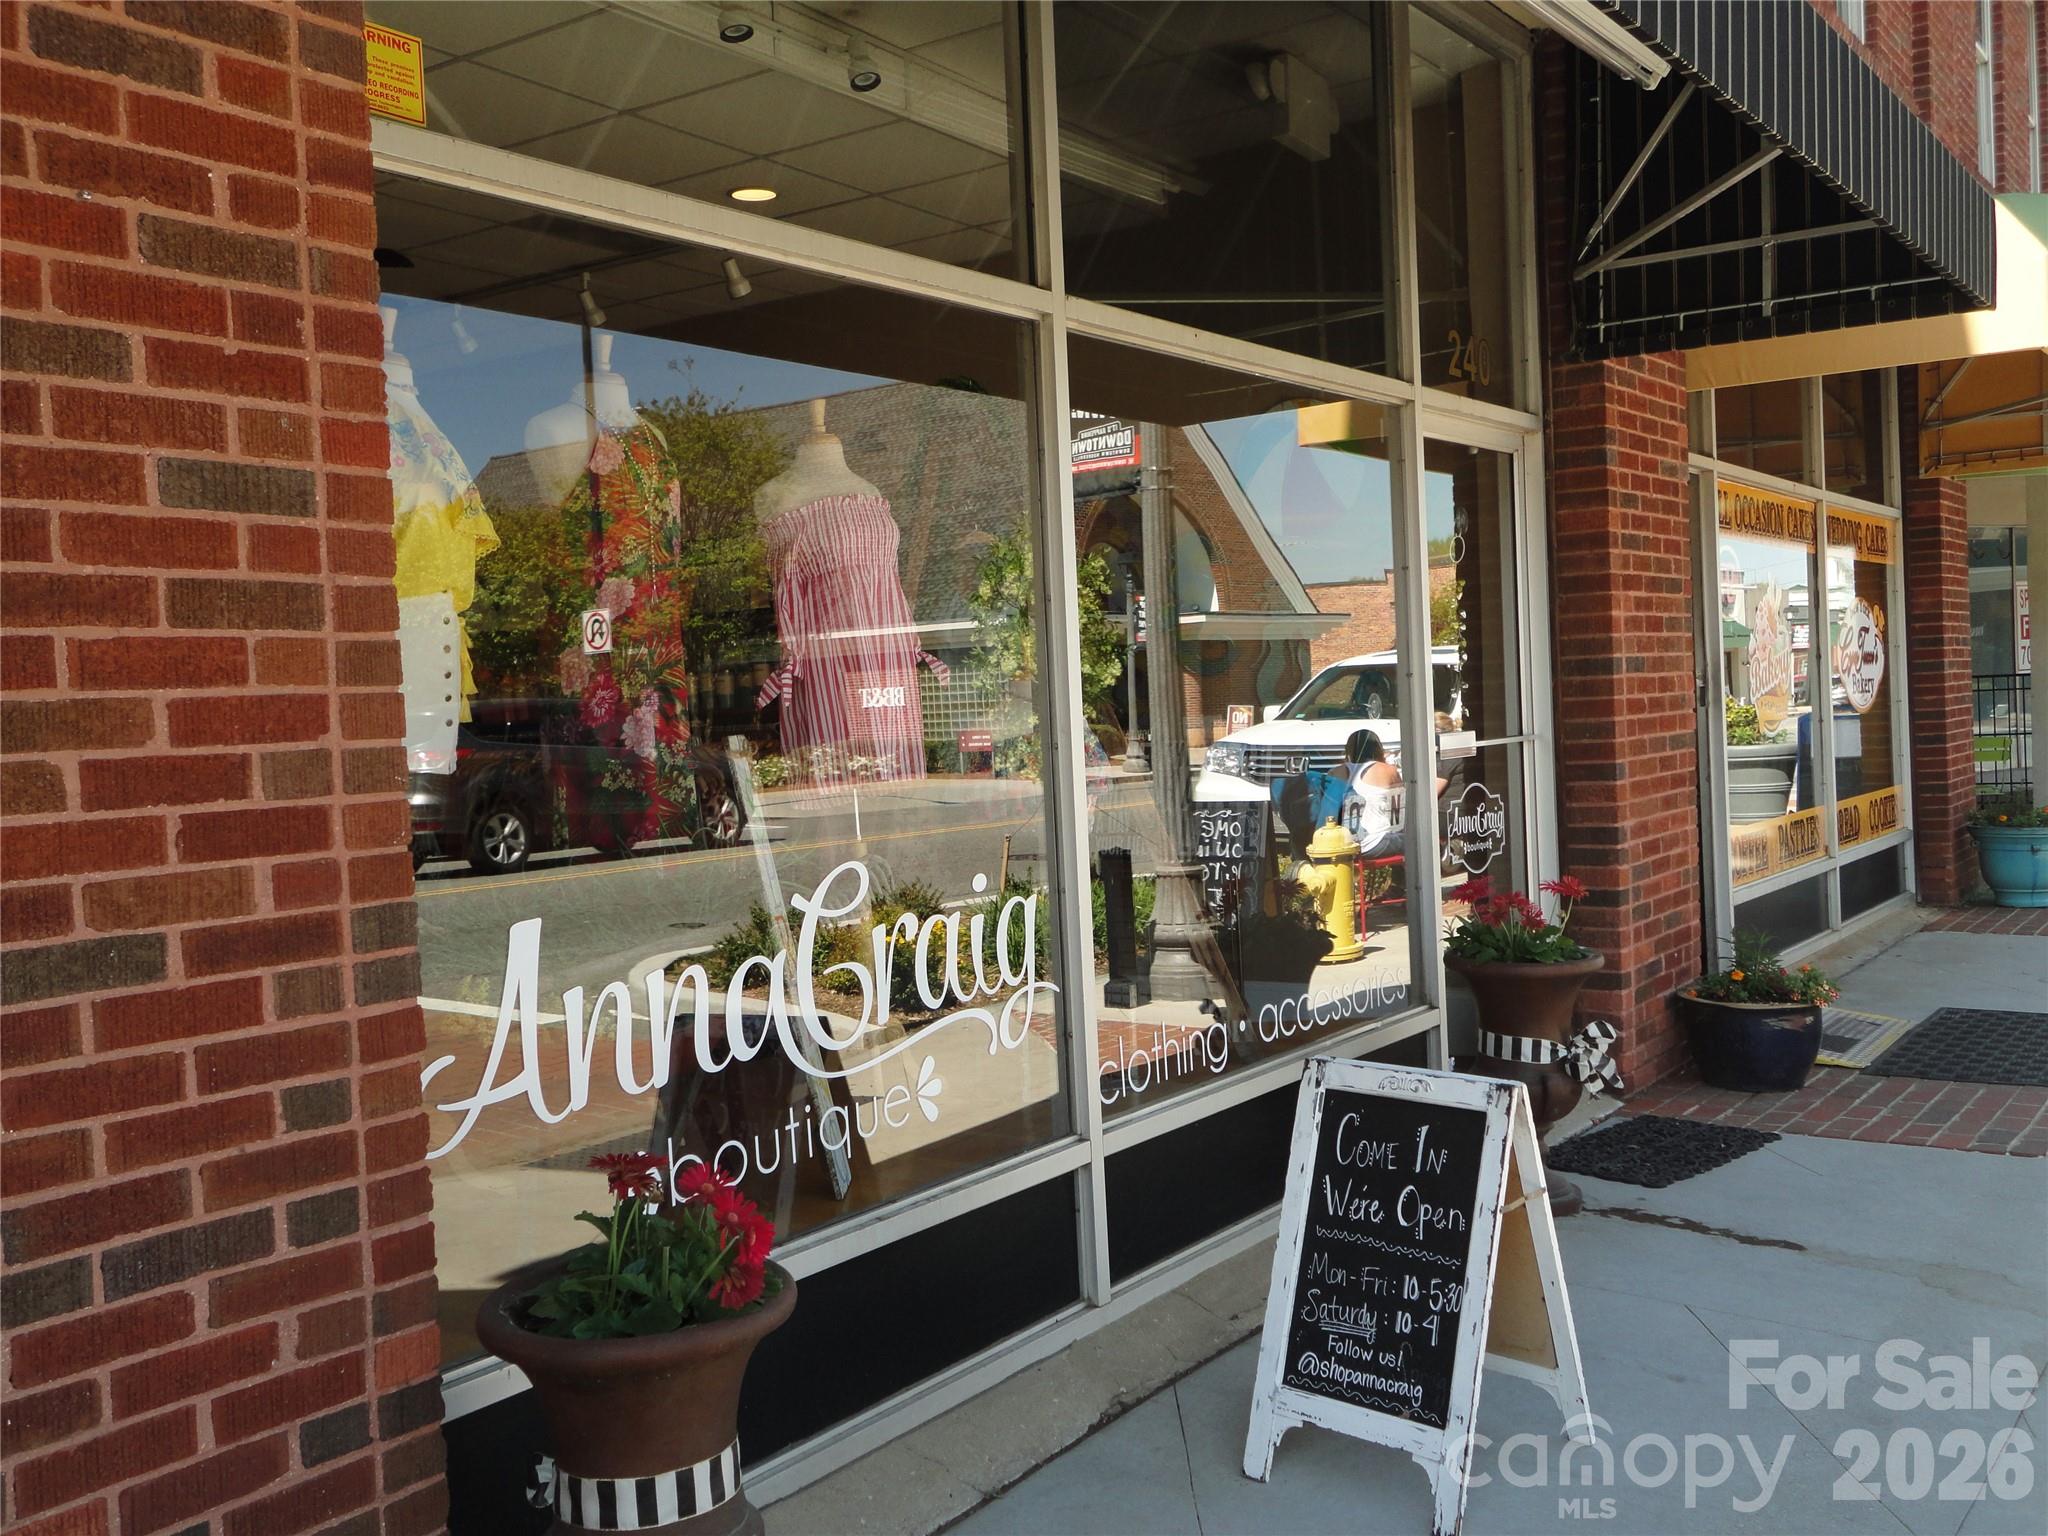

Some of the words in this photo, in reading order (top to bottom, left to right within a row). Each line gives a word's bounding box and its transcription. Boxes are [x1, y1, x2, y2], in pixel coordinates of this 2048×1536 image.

[363, 30, 411, 54] RNING
[365, 88, 401, 104] OGRESS
[379, 81, 420, 100] RECORDING
[1448, 329, 1490, 386] 240
[1717, 489, 1731, 530] LL
[1734, 493, 1784, 538] OCCASION
[1865, 522, 1888, 556] CAKES
[1852, 672, 1875, 698] Bakery
[1449, 802, 1505, 838] AnnaCraig
[1838, 804, 1860, 845] READ
[1731, 829, 1768, 879] OFFEE
[1778, 814, 1820, 864] PASTRIES
[421, 860, 1060, 1160] AnnaCraig
[1099, 1020, 1229, 1105] clothing
[1258, 965, 1407, 1043] accessories
[667, 1083, 911, 1208] boutique
[1397, 1184, 1466, 1240] Open
[1327, 1334, 1374, 1362] Follow
[1298, 1352, 1423, 1407] @shopannacraig
